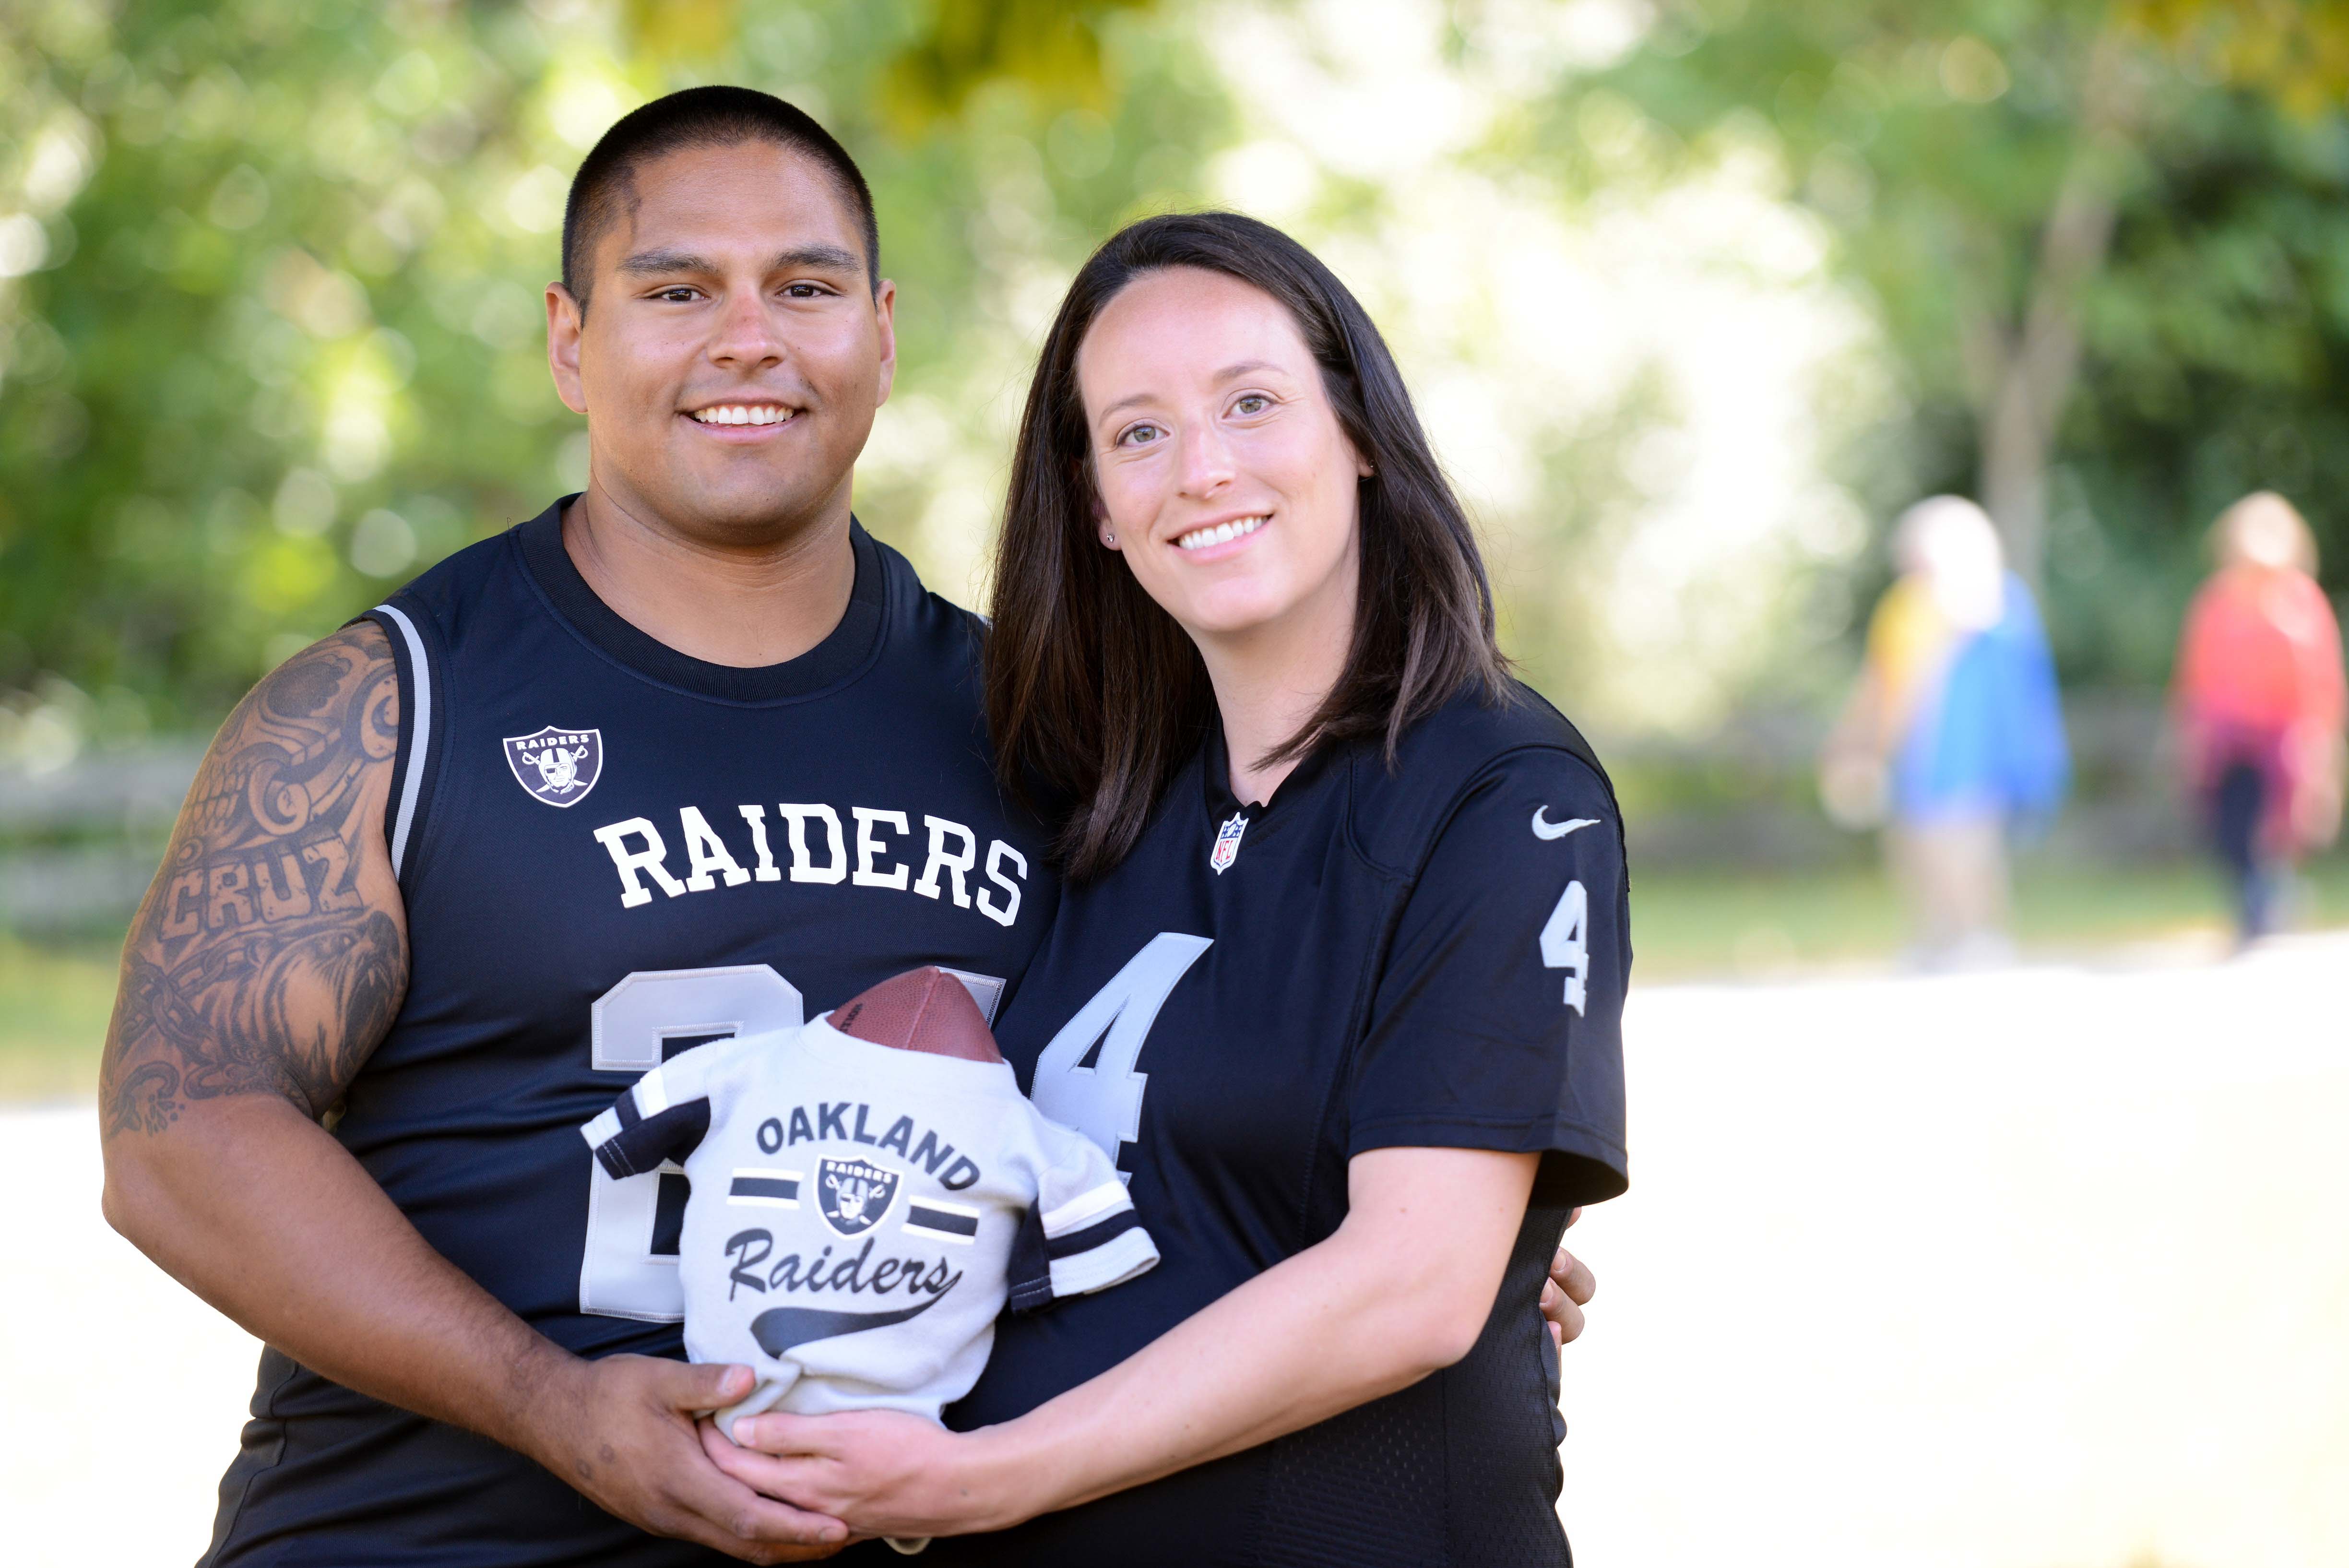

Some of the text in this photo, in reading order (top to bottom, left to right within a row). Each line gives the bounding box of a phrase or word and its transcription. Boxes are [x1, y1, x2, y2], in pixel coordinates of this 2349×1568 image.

[515, 734, 590, 750] RAIDERS
[159, 835, 364, 942] CRUZ
[593, 803, 1028, 927] RAIDERS
[1215, 840, 1234, 863] NFL
[1539, 880, 1589, 1018] 4
[1030, 932, 1215, 1188] 4
[756, 1102, 980, 1191] OAKLAND
[826, 1161, 892, 1184] RAIDERS
[725, 1227, 963, 1302] Raiders
